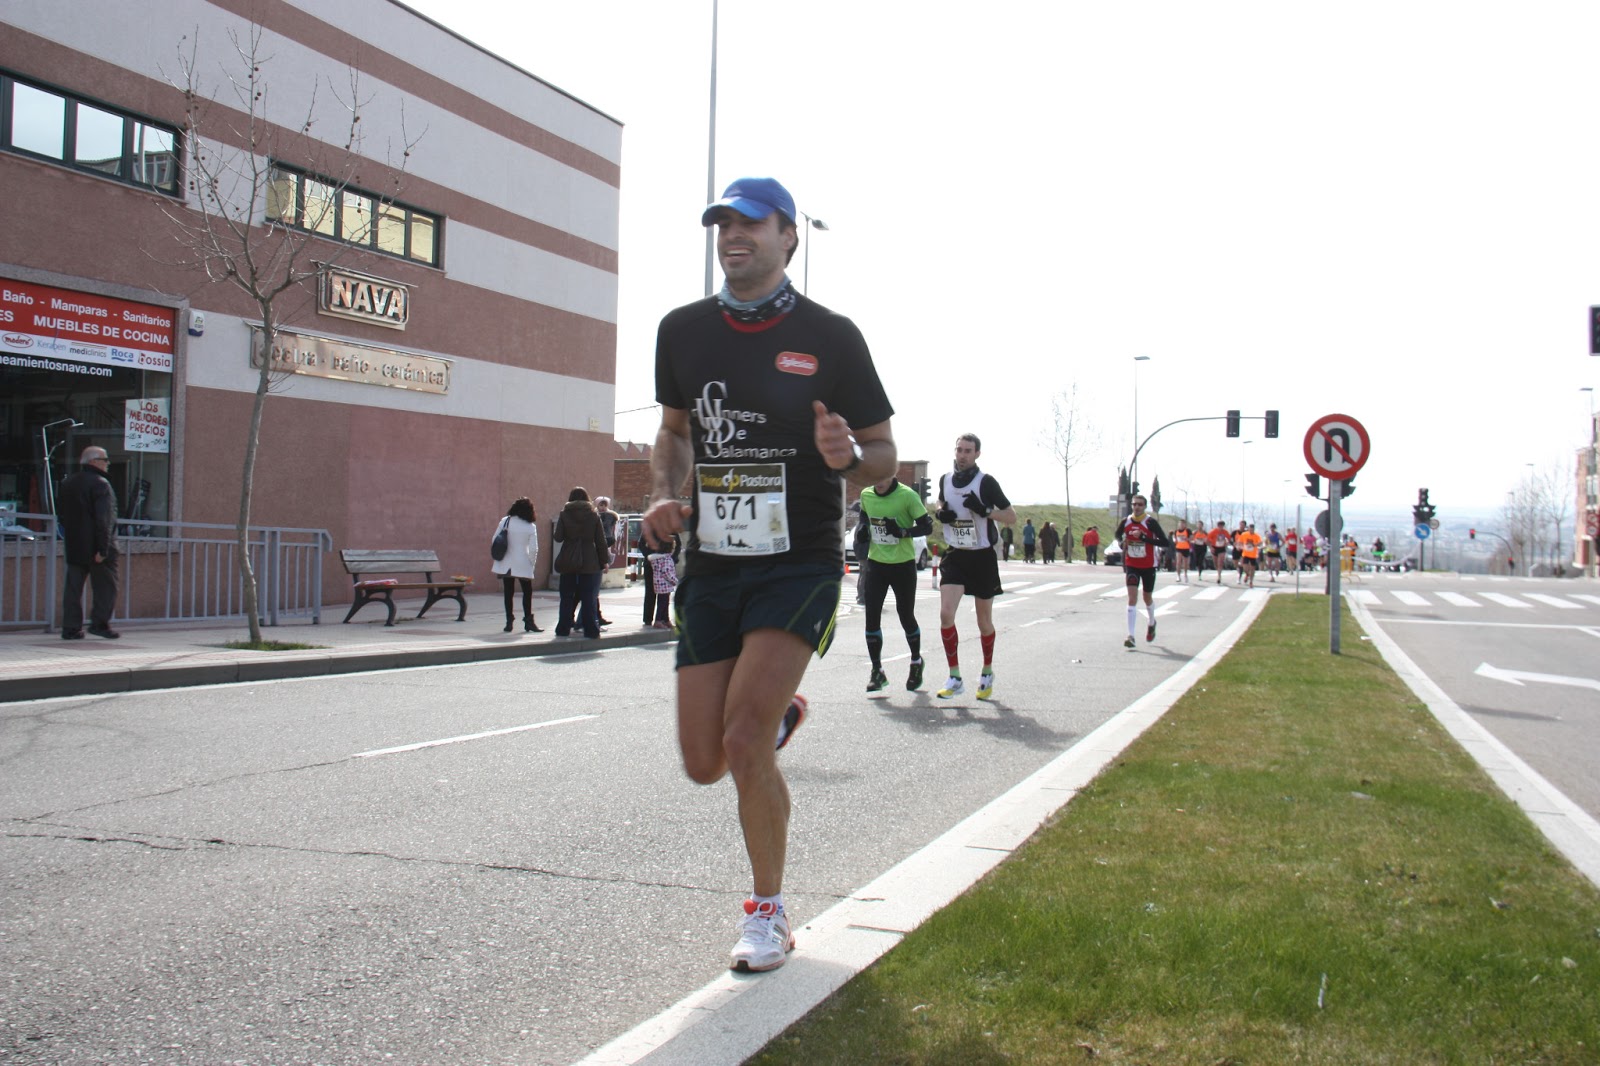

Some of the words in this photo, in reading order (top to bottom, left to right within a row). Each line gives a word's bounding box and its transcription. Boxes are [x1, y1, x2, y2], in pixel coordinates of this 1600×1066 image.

[331, 275, 402, 319] NAVA
[3, 289, 34, 305] Baño
[51, 298, 108, 318] Mamparas
[123, 310, 171, 328] Sanitarios
[34, 315, 99, 335] MUEBLES
[102, 325, 120, 339] DE
[123, 329, 170, 346] COCINA
[111, 348, 134, 359] Roca
[140, 401, 159, 413] LOS
[129, 410, 168, 426] MEJORES
[129, 421, 165, 437] PRECIOS
[740, 474, 782, 487] Pastora
[715, 495, 756, 520] 671
